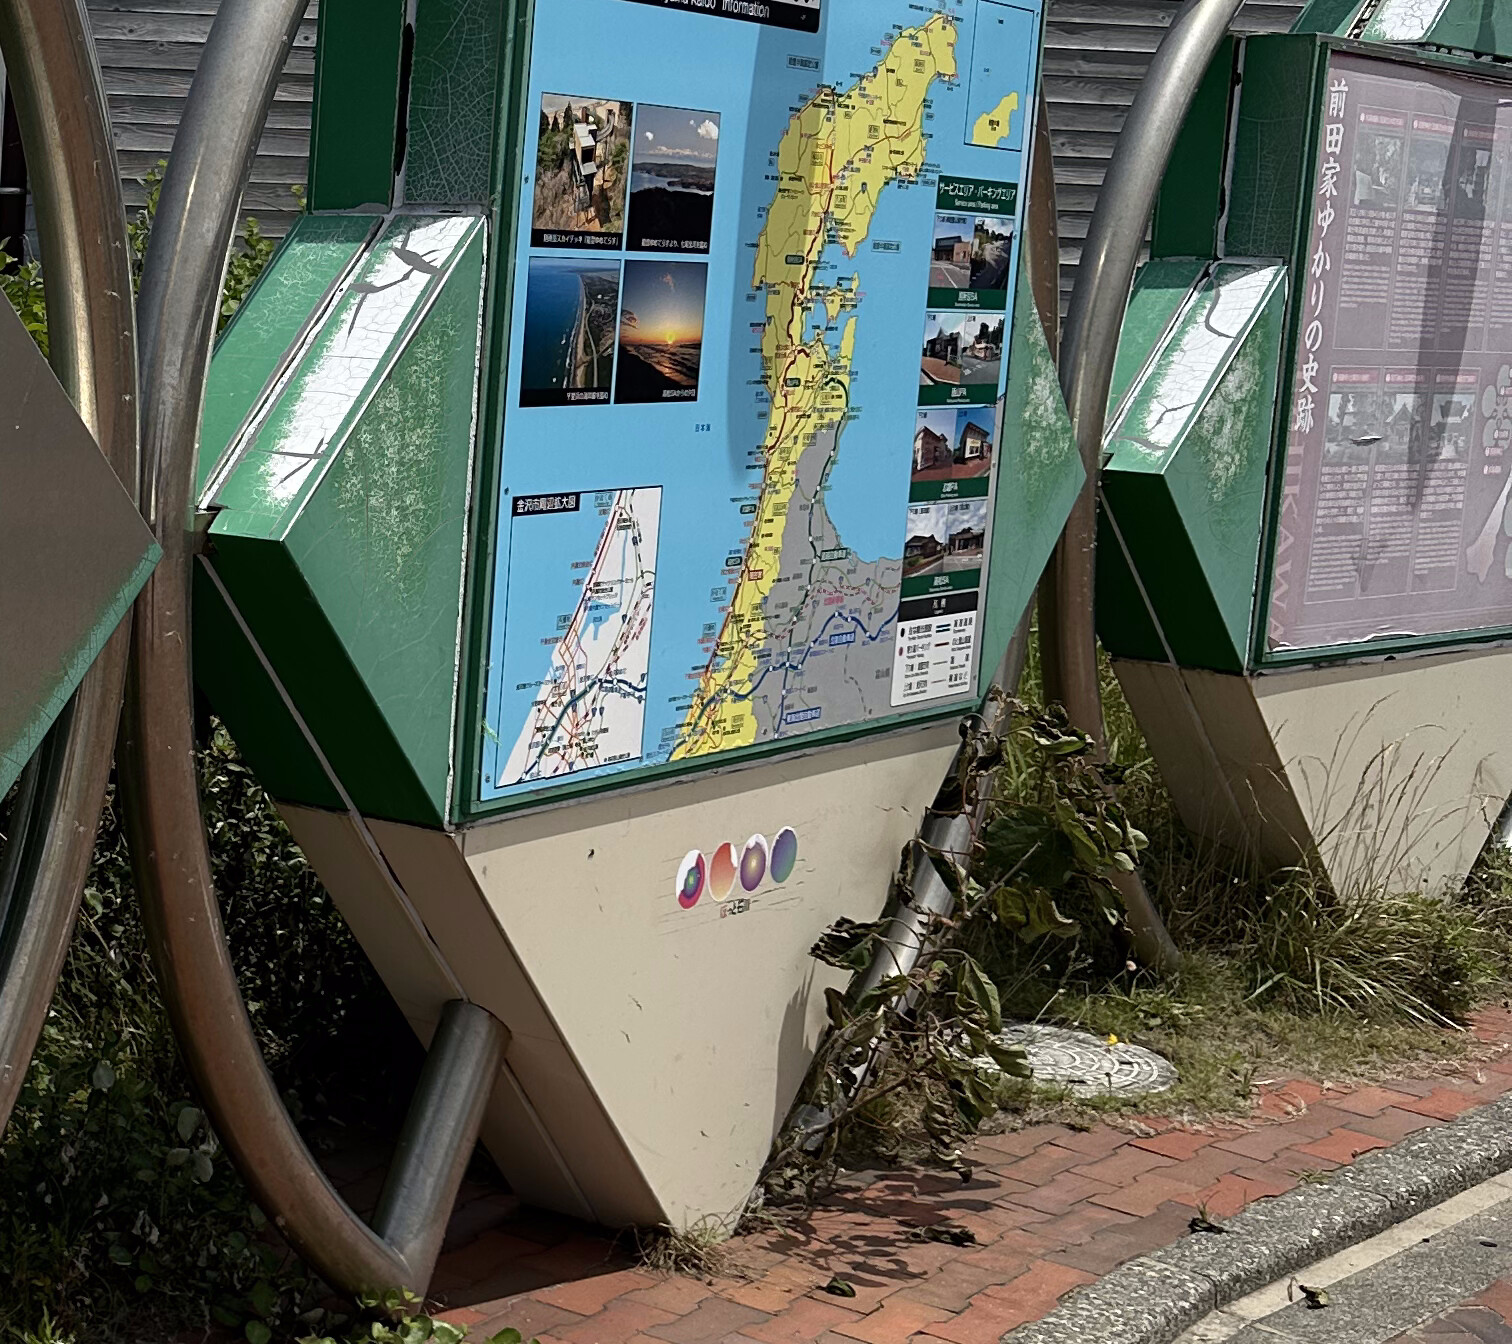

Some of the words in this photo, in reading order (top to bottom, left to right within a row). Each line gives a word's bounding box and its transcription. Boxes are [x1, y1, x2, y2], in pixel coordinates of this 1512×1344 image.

[1294, 78, 1349, 434] 前田家ゆかりの史跡
